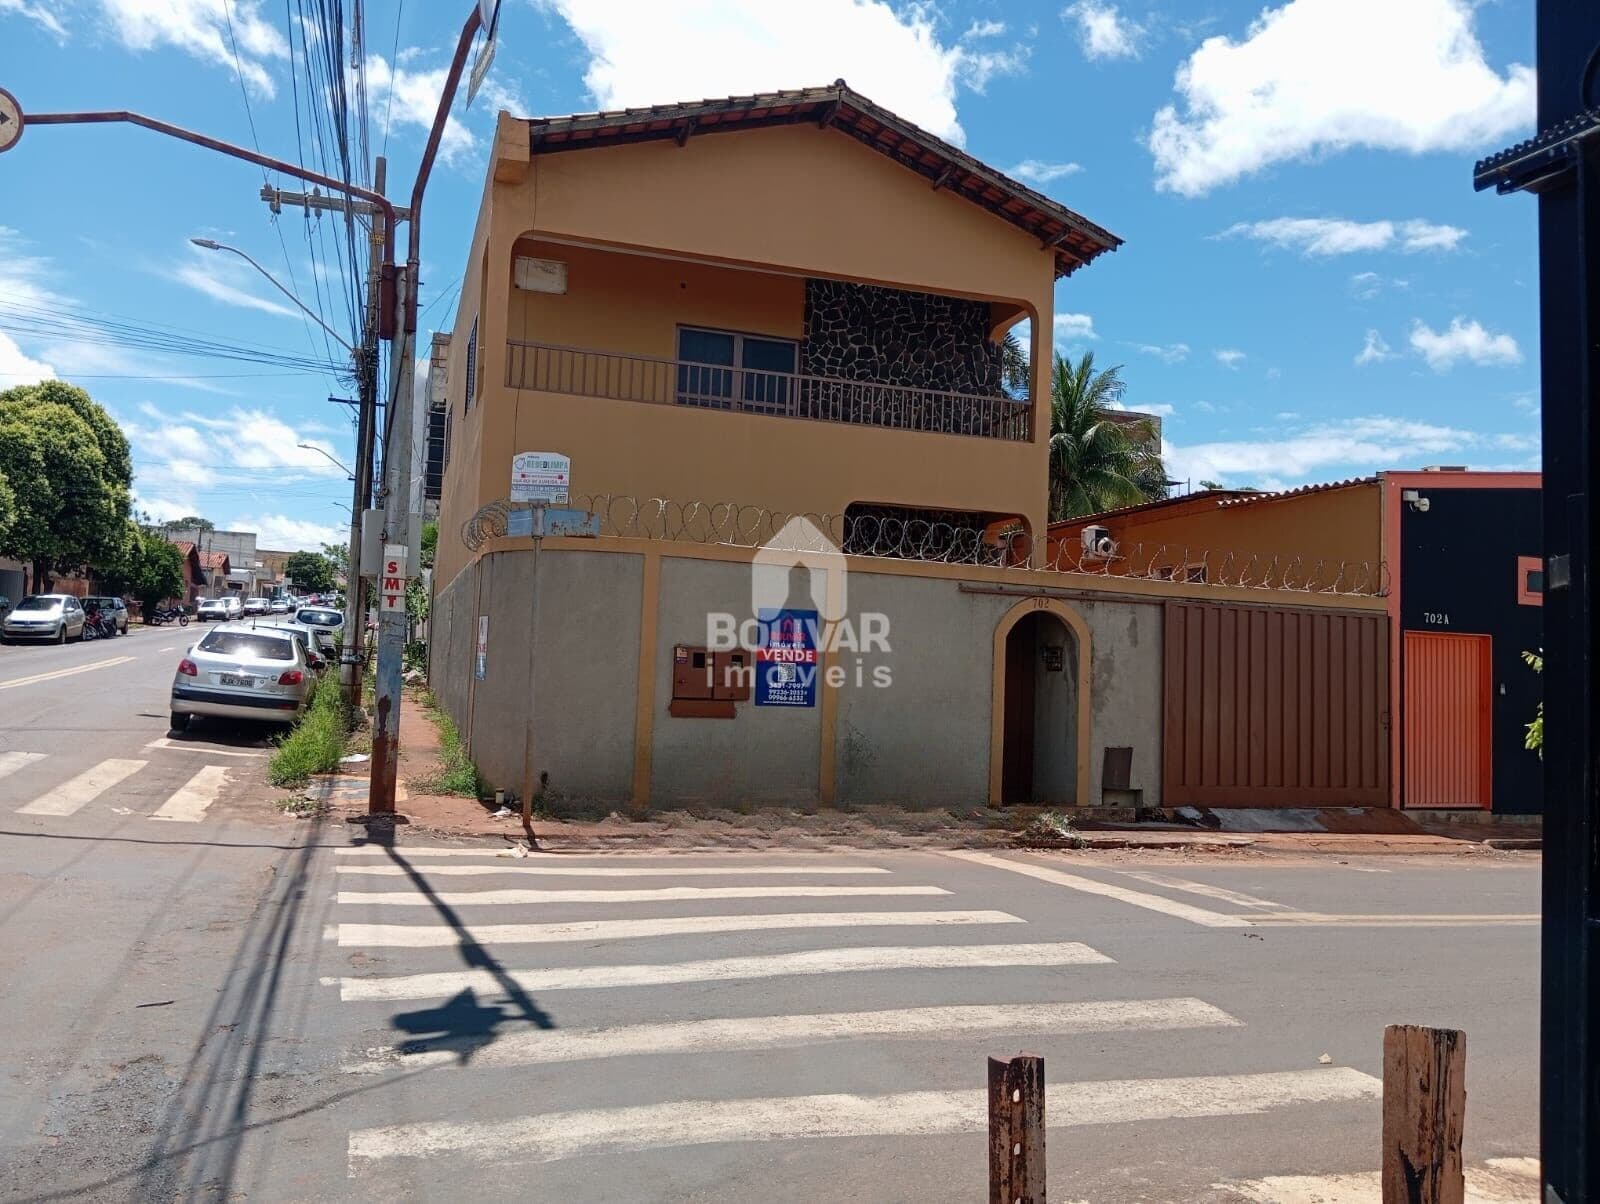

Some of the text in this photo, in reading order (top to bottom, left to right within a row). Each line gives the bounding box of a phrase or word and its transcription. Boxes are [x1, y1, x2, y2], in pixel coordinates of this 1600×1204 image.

[1033, 598, 1049, 609] 702
[1423, 612, 1450, 625] 702A
[762, 649, 814, 662] VENDE
